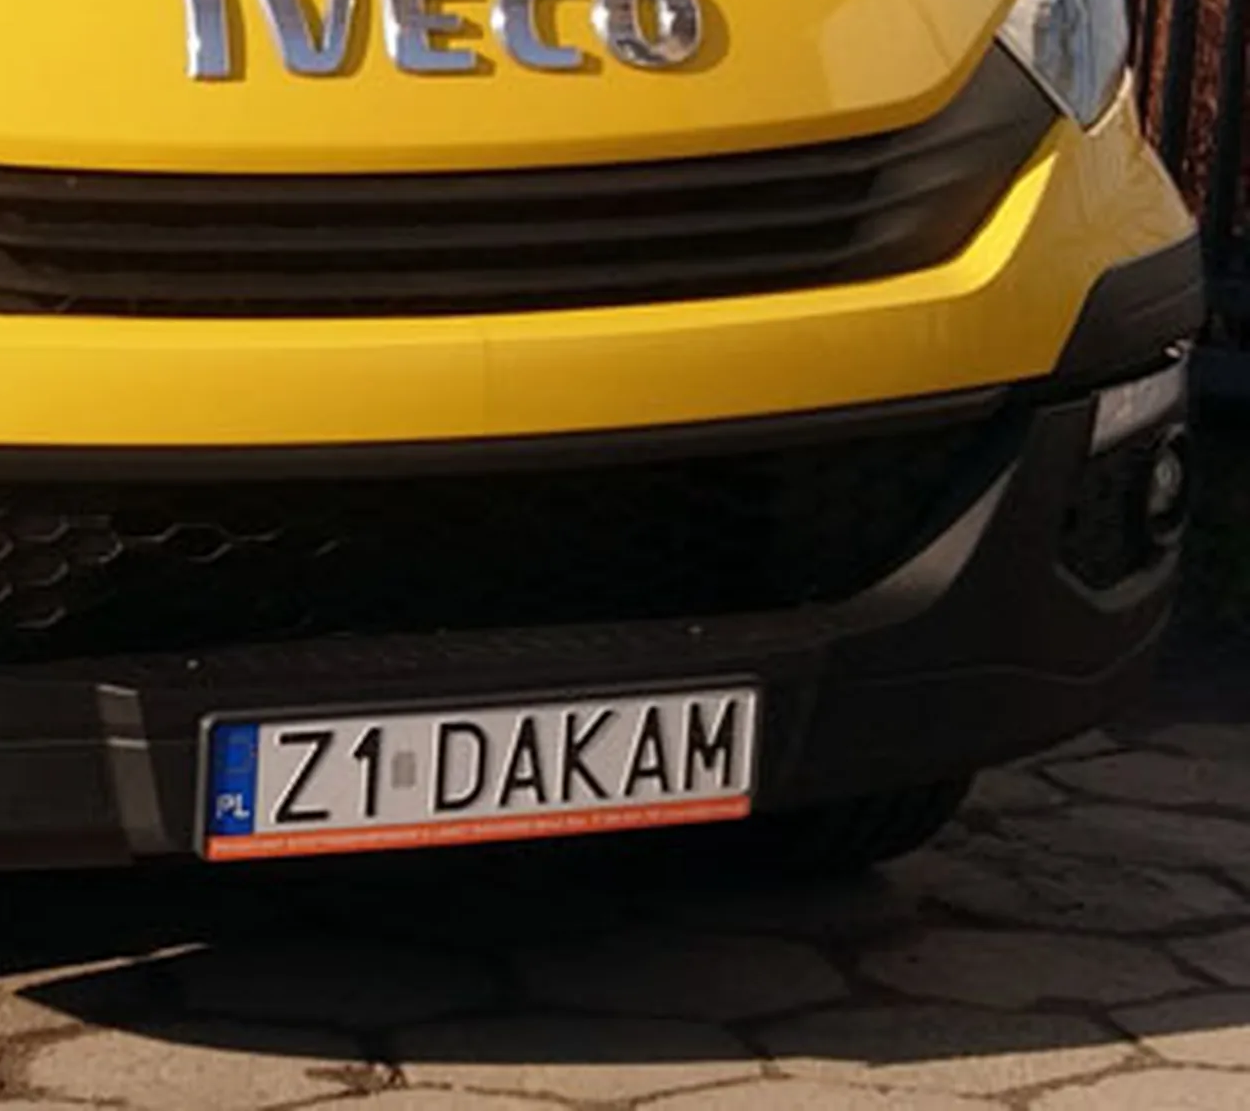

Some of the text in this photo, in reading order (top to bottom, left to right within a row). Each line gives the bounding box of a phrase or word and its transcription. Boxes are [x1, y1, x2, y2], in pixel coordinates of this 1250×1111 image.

[274, 699, 737, 823] Z1 DAKAM
[215, 793, 250, 820] PL
